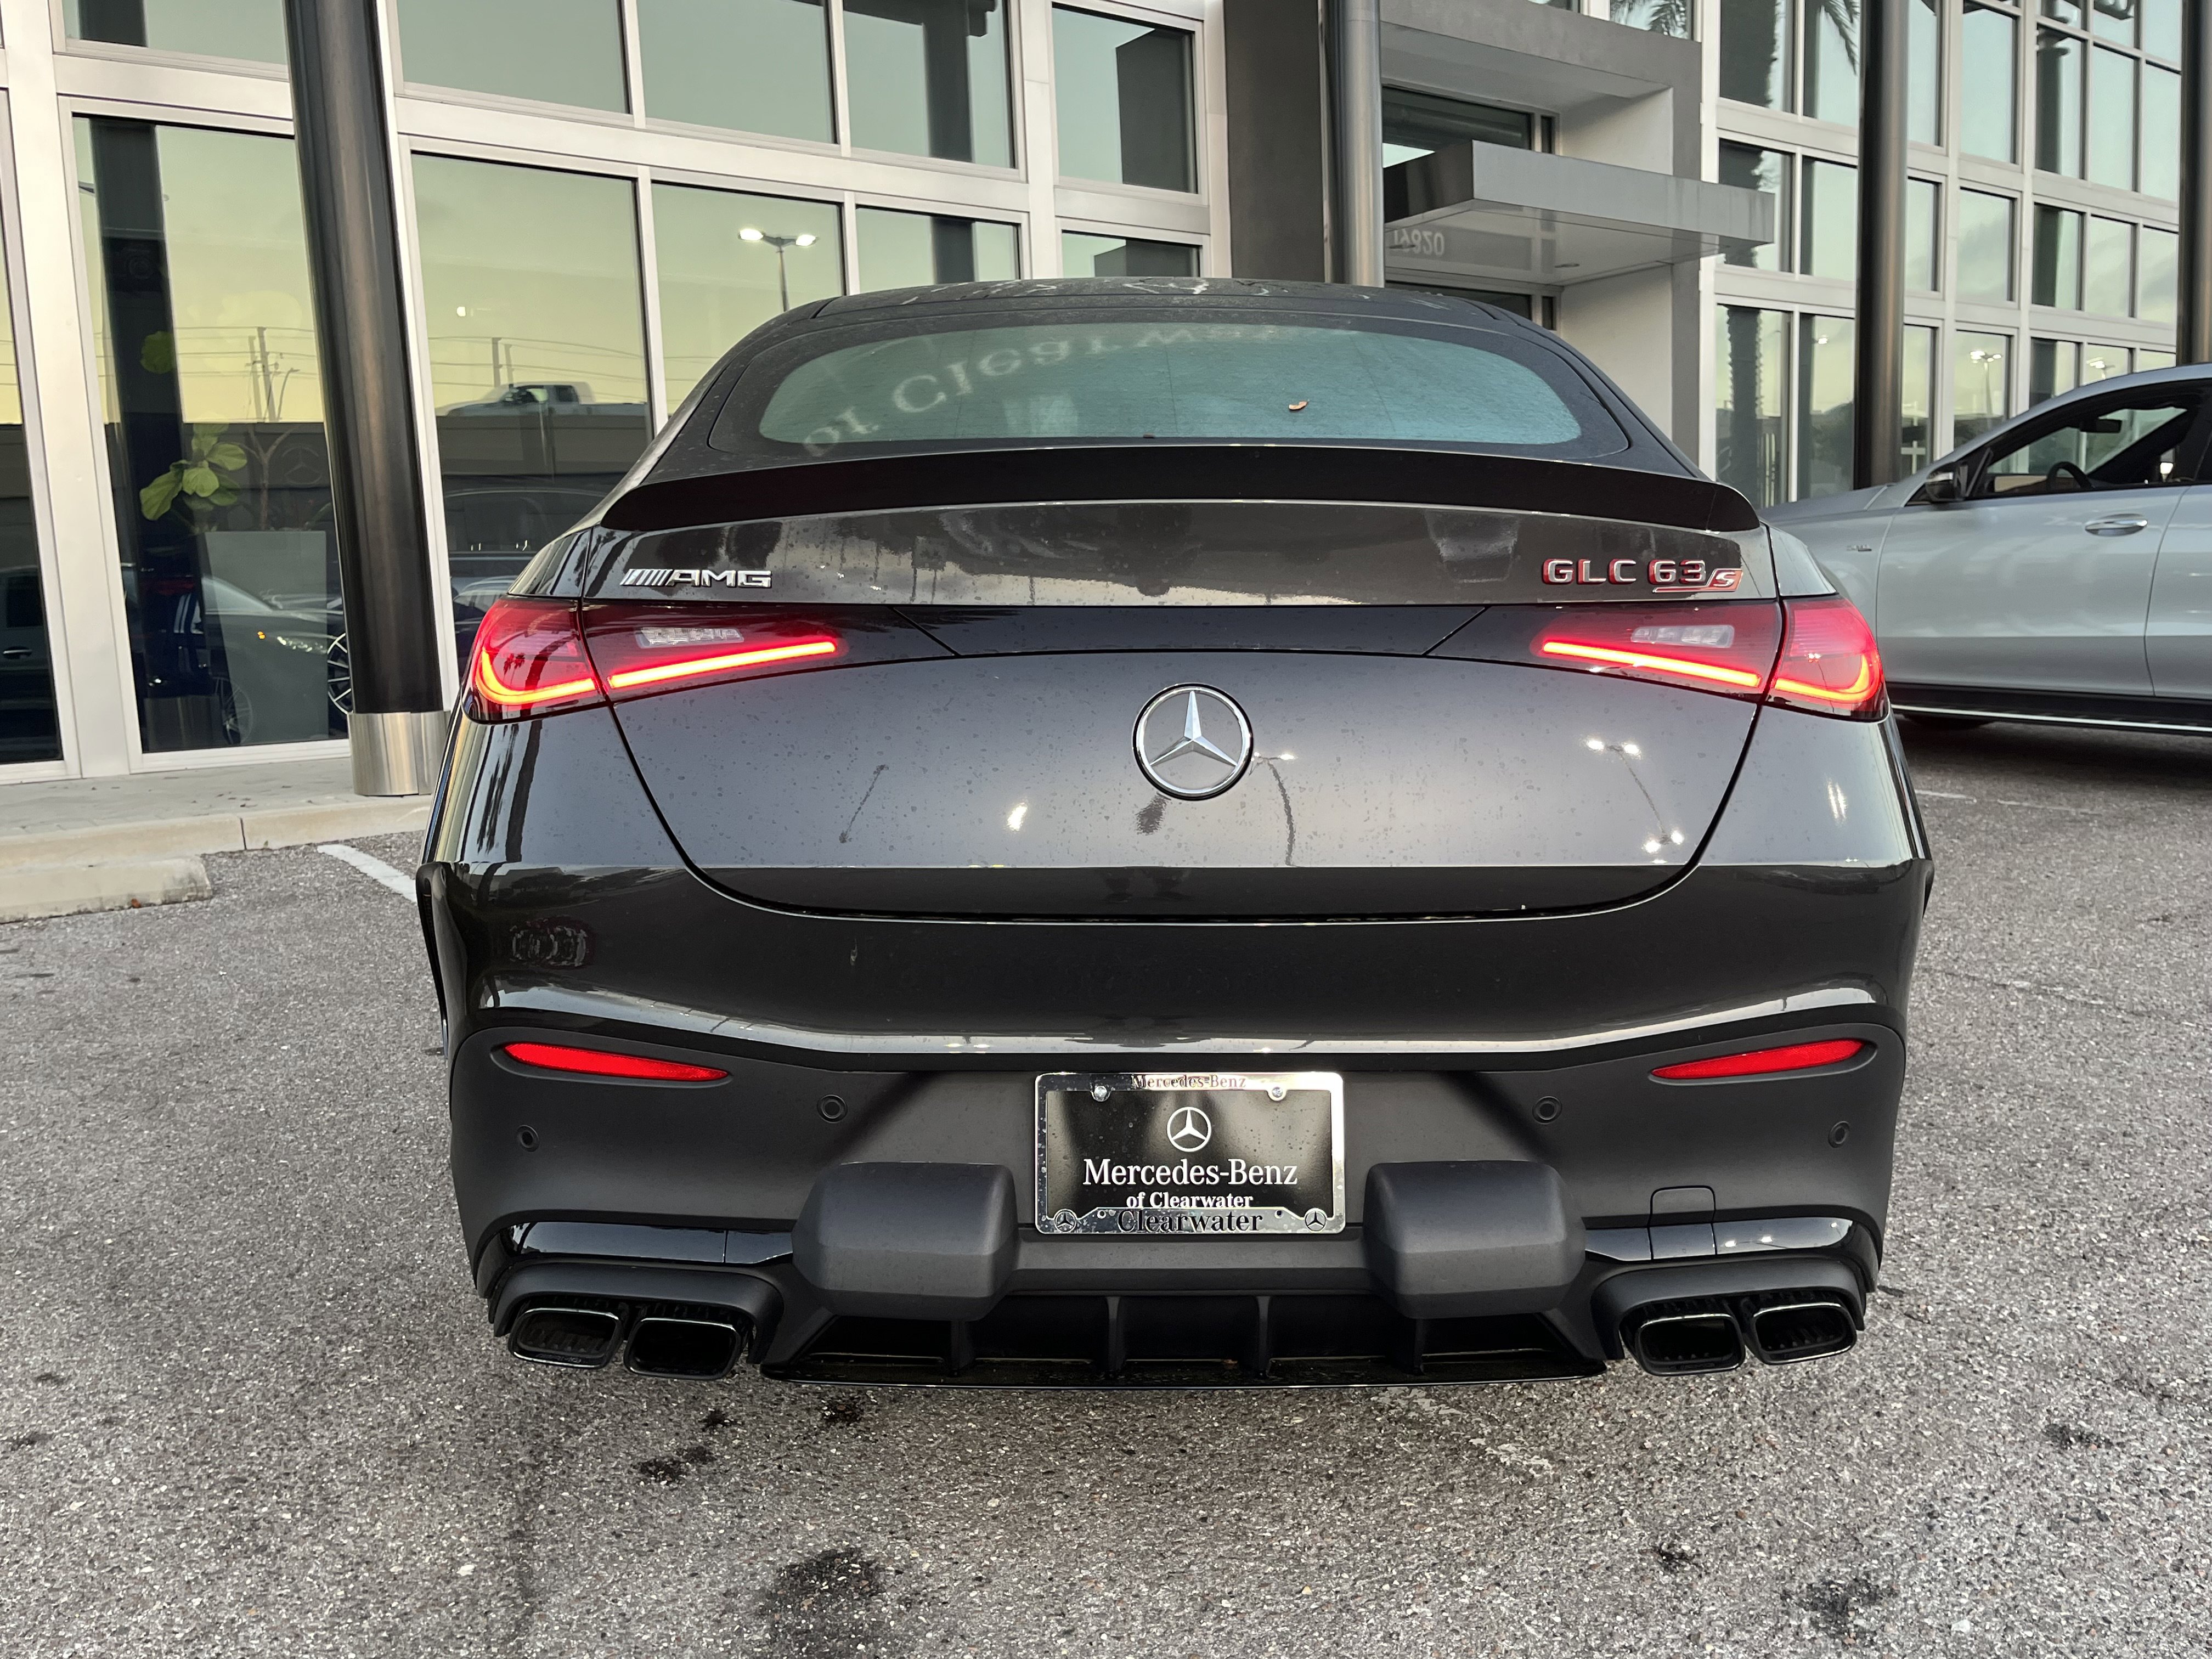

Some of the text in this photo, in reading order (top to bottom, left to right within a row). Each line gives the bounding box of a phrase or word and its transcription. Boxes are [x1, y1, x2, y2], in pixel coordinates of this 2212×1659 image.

[1542, 558, 1637, 585] GLC
[1131, 1074, 1246, 1089] Mercedes-Benz
[1082, 1158, 1298, 1186] Mercedes-Benz
[1126, 1191, 1254, 1207] of Clearwater
[1117, 1209, 1263, 1233] Clearwater
